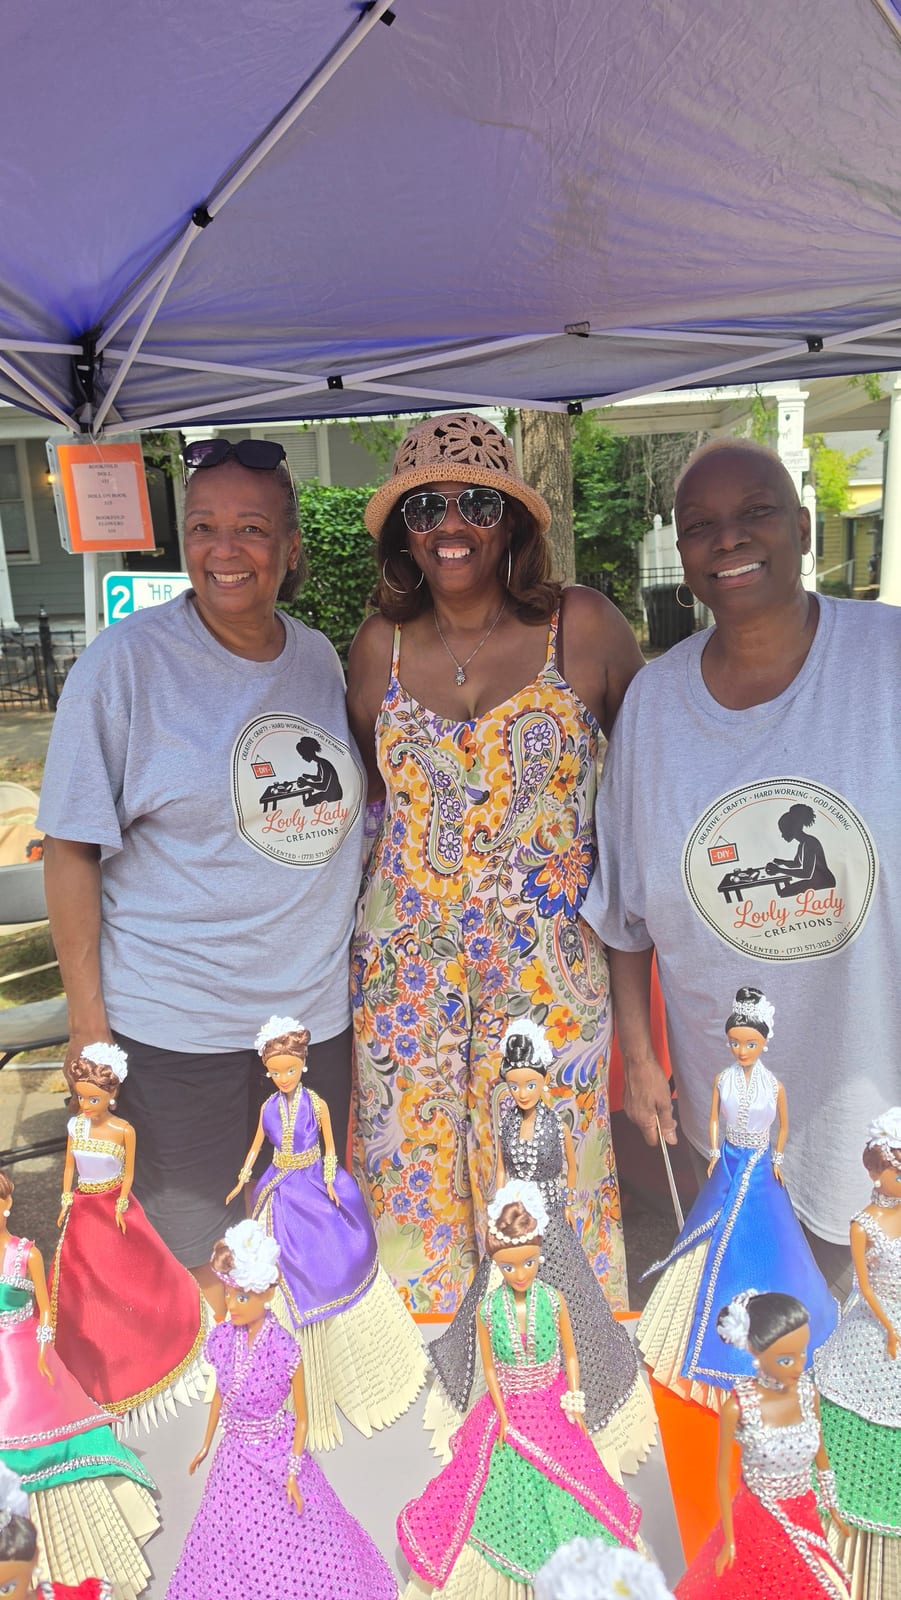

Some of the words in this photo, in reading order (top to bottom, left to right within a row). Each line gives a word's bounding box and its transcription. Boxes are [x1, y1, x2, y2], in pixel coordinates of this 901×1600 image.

[111, 585, 131, 619] 2
[151, 584, 173, 601] HR
[242, 738, 255, 761] CREATIVE
[253, 725, 269, 739] CRAFTY
[286, 722, 310, 734] WORKING
[261, 808, 306, 833] Lovly
[310, 800, 349, 826] Lady
[698, 816, 721, 846] CREATIVE
[722, 796, 748, 815] CRAFTY
[753, 789, 773, 800] HARD
[774, 788, 809, 800] WORKING
[813, 796, 829, 809] GOD
[828, 805, 852, 831] FEARING
[286, 826, 339, 843] CREATIONS
[266, 843, 297, 860] TALENTED
[733, 899, 789, 928] Lovly
[794, 888, 846, 918] Lady
[764, 917, 833, 938] CREATIONS
[741, 940, 780, 955] TALENTED
[786, 946, 803, 956] (773)
